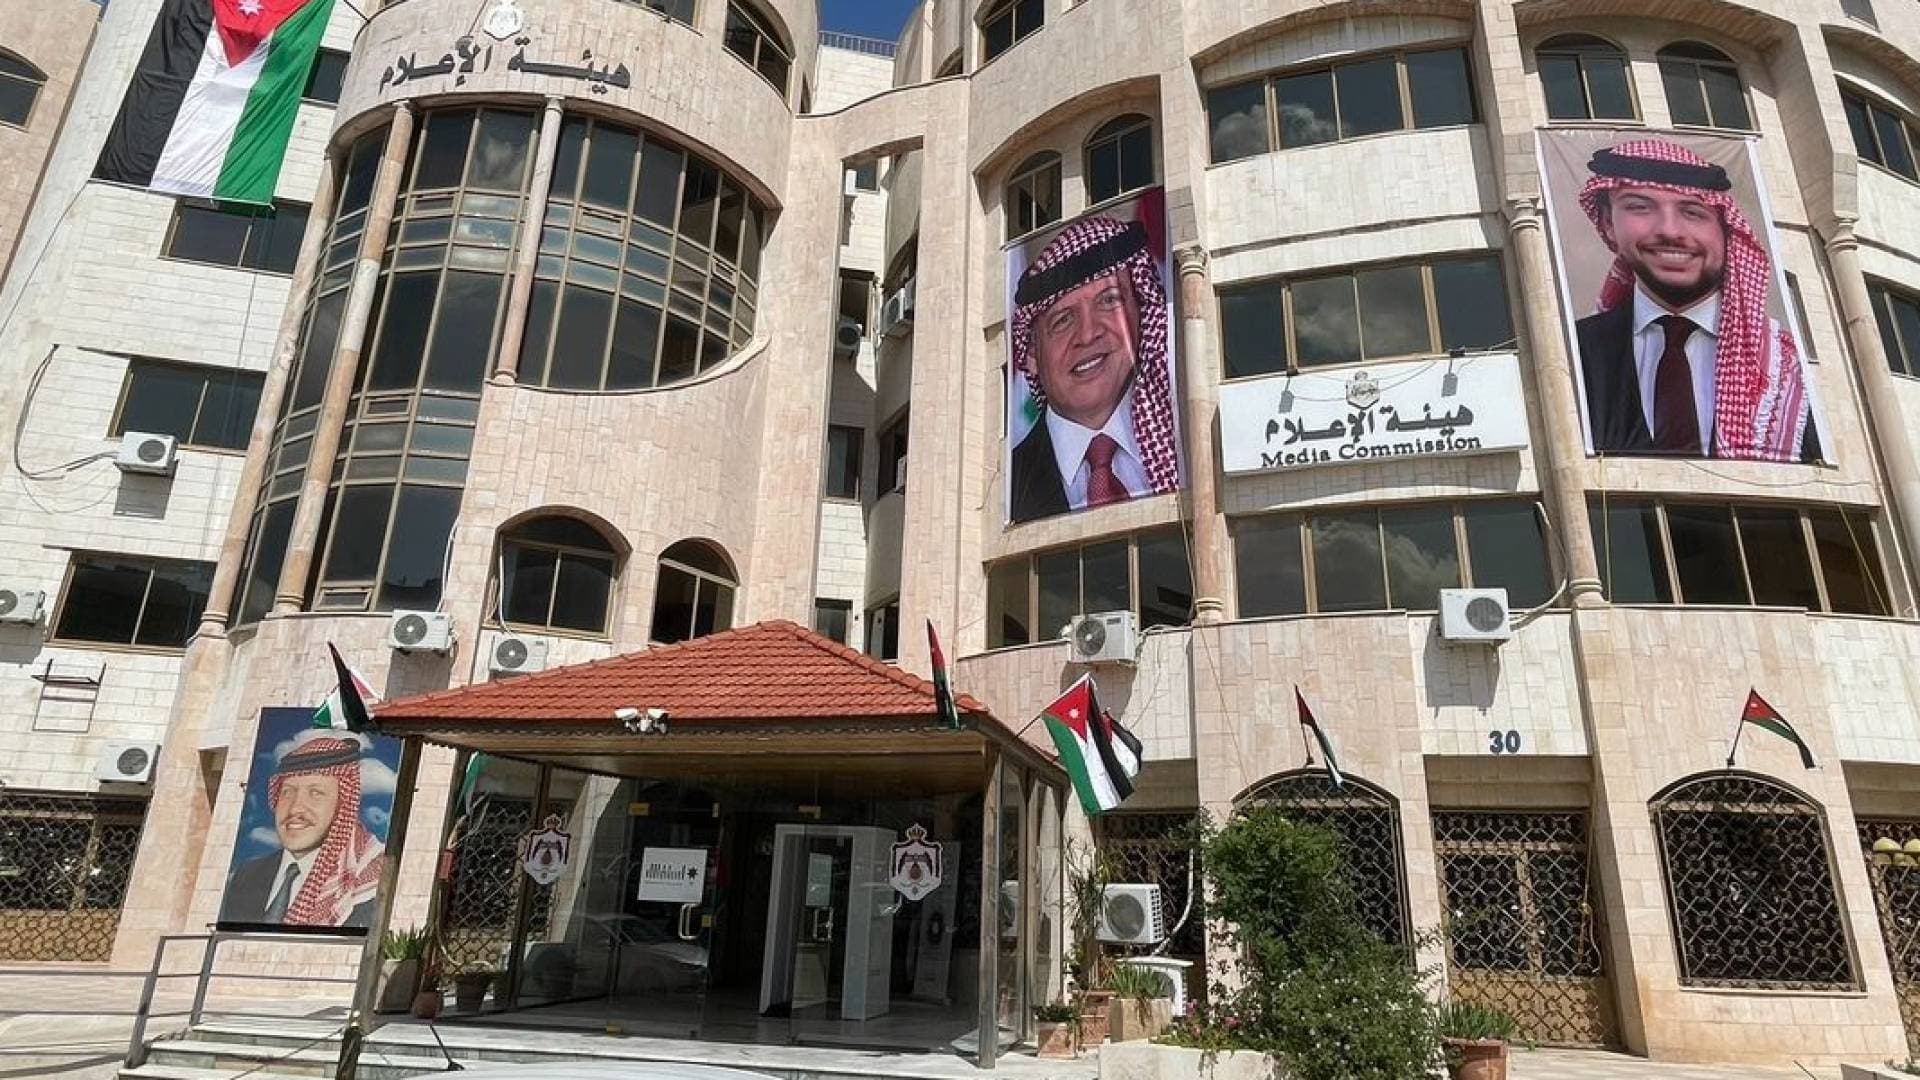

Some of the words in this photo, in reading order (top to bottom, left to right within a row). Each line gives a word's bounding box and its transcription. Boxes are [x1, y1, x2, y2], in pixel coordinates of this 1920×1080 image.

[379, 39, 492, 94] الإعلام
[507, 37, 631, 95] هيئة
[1264, 408, 1375, 446] الإعلام
[1380, 403, 1473, 436] هيئة
[1261, 445, 1331, 467] Media
[1338, 436, 1482, 460] Commission
[1489, 730, 1521, 753] 30
